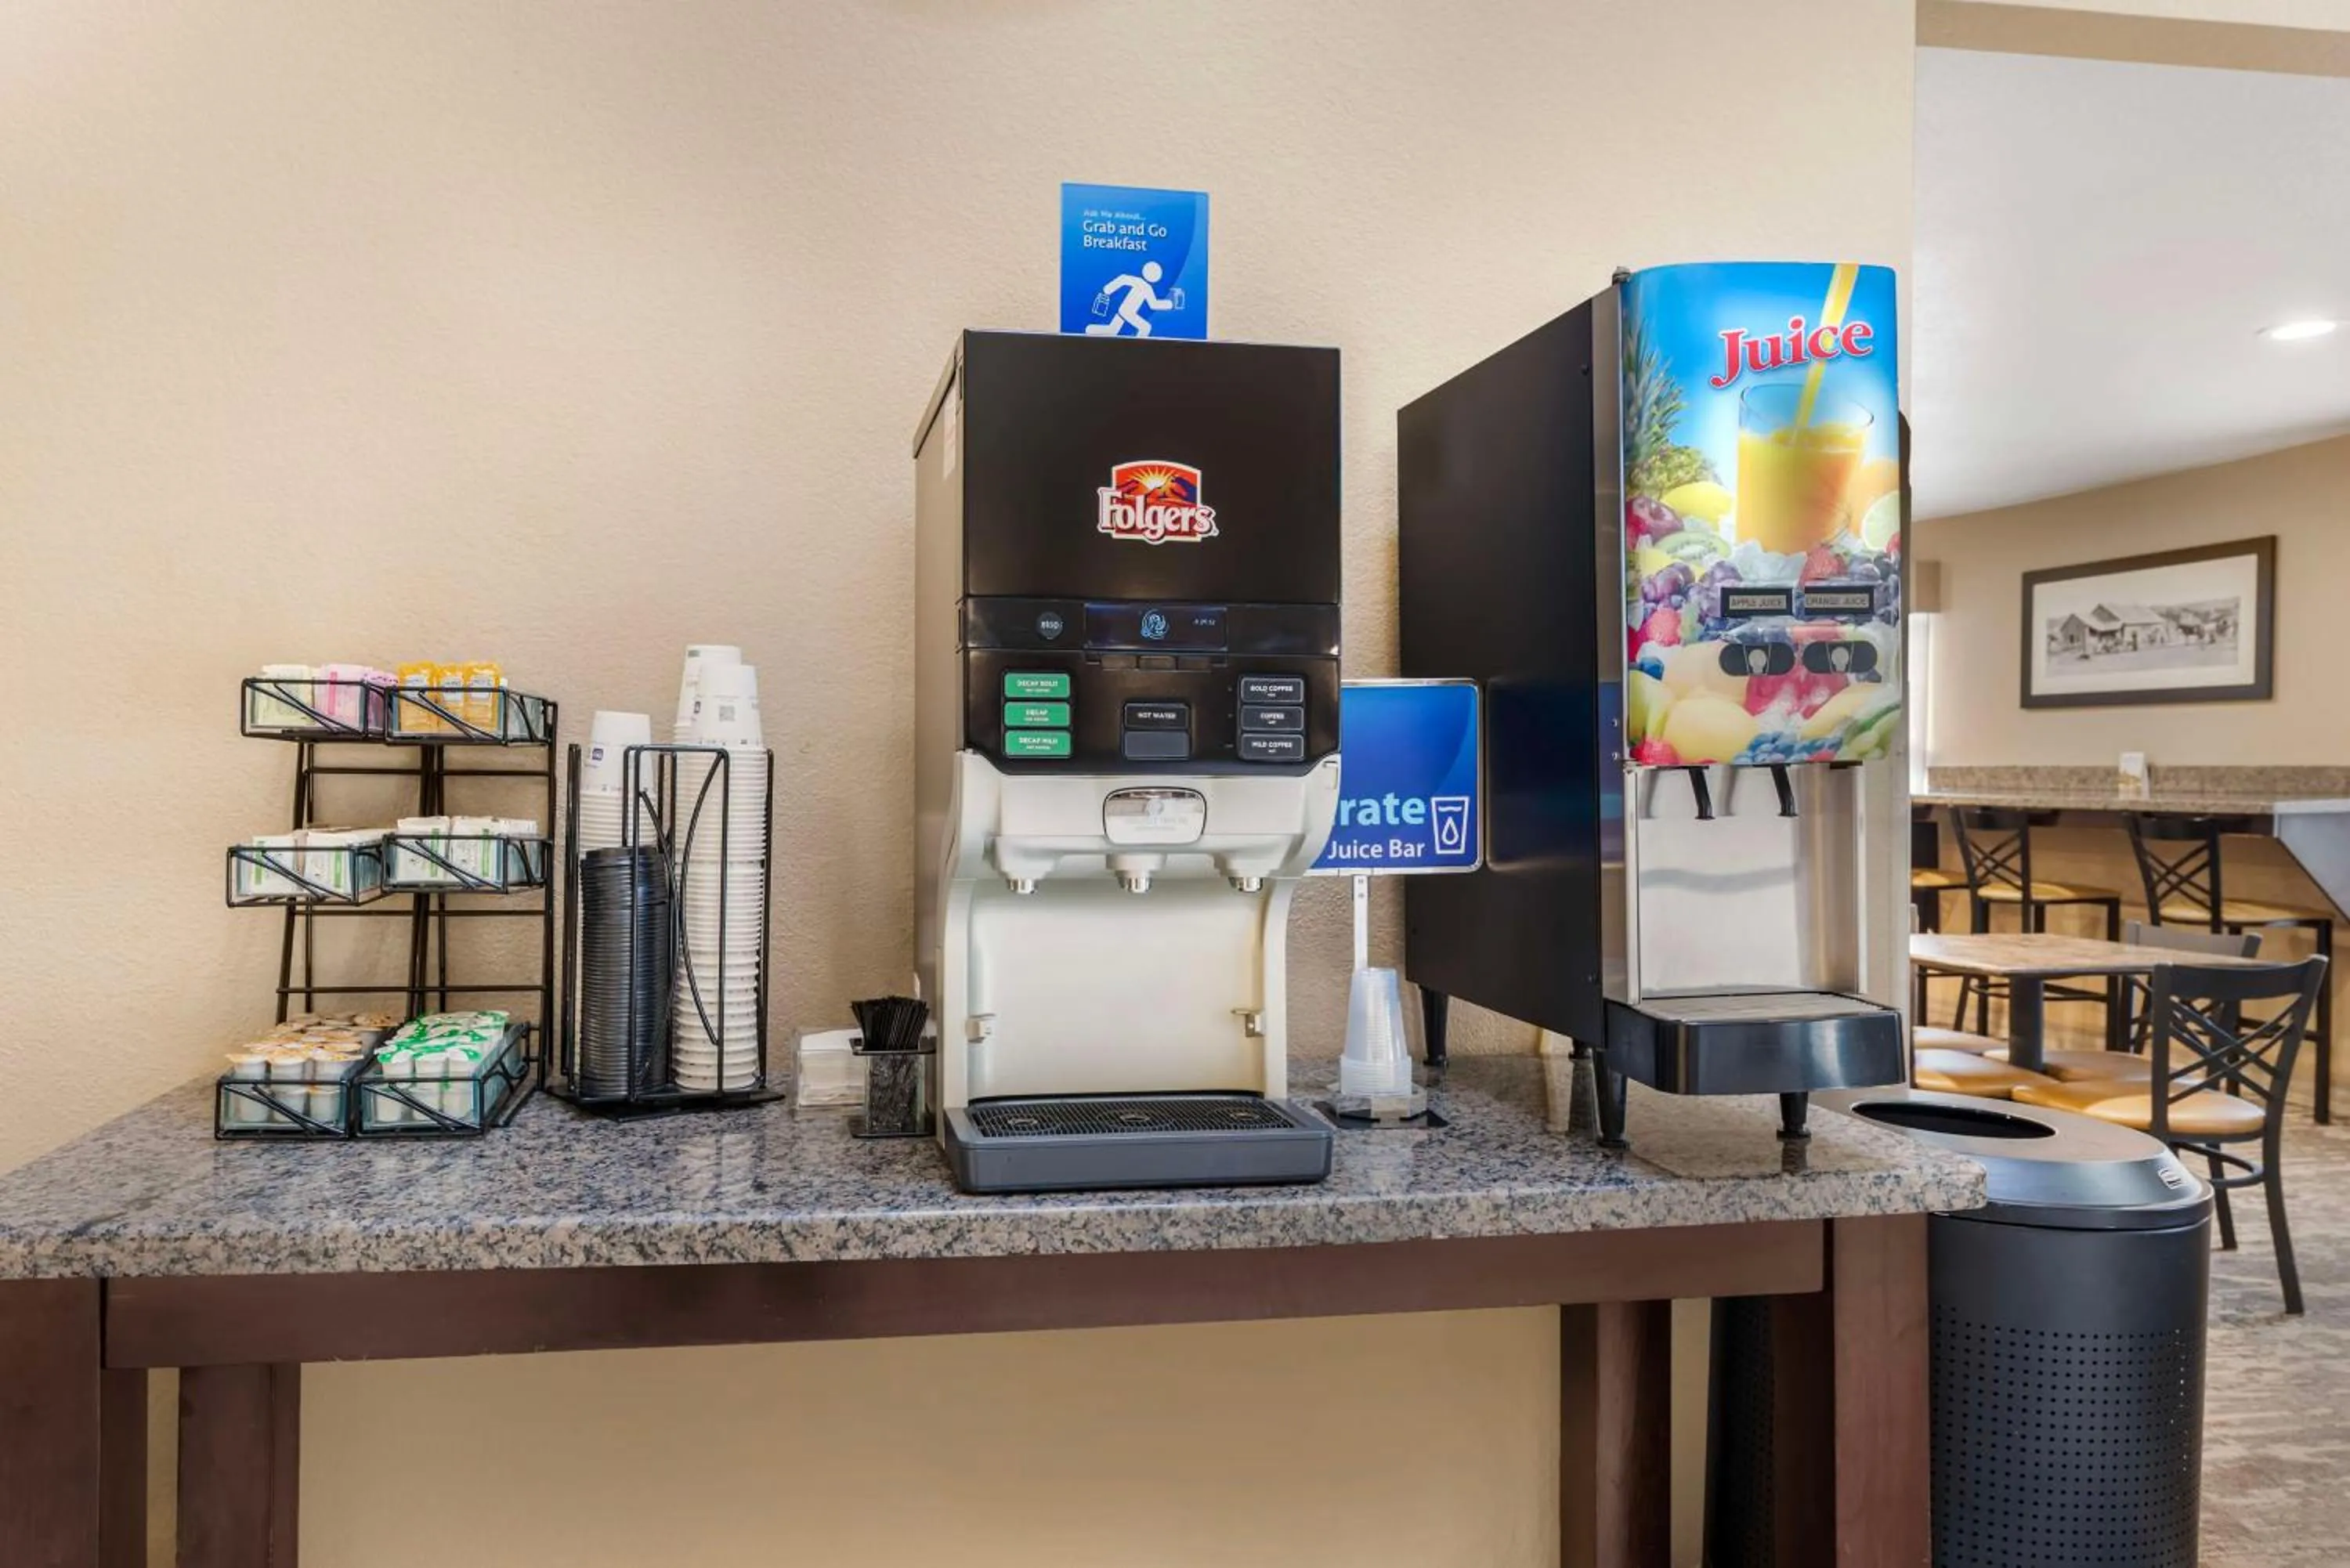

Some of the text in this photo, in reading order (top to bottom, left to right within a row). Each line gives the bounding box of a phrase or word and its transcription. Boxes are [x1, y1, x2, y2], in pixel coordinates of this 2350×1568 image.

[1083, 220, 1167, 237] Grab and Go
[1083, 234, 1148, 251] Breakfast
[1709, 315, 1873, 389] Juice
[1100, 490, 1213, 540] Folgers
[1340, 792, 1426, 826] rate
[1328, 839, 1426, 860] Juice Bar
